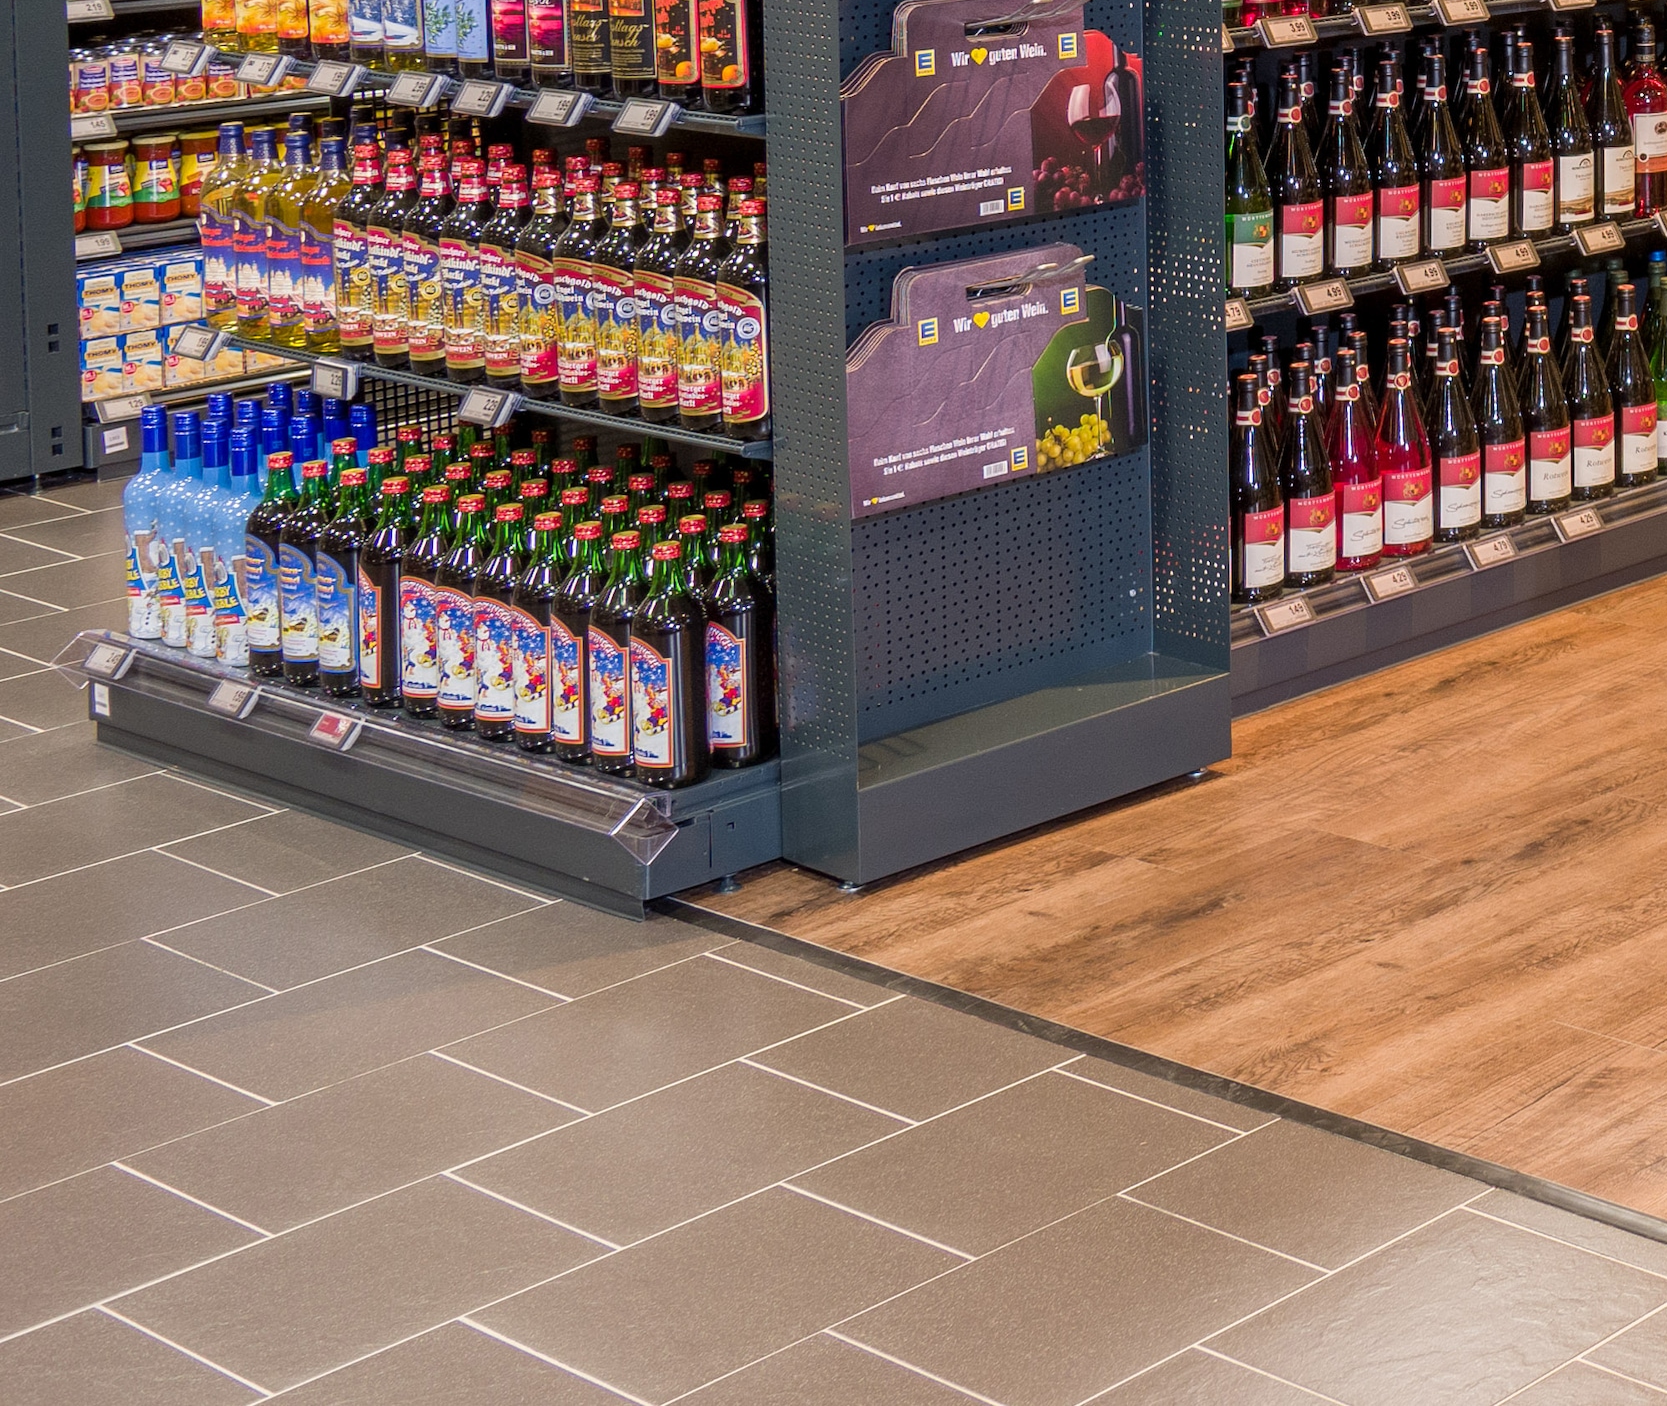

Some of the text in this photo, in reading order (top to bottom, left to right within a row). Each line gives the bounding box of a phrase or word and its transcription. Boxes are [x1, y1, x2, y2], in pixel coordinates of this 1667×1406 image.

[951, 43, 1047, 67] Wir guten Wein.
[953, 302, 1048, 333] Wir guten Wein.
